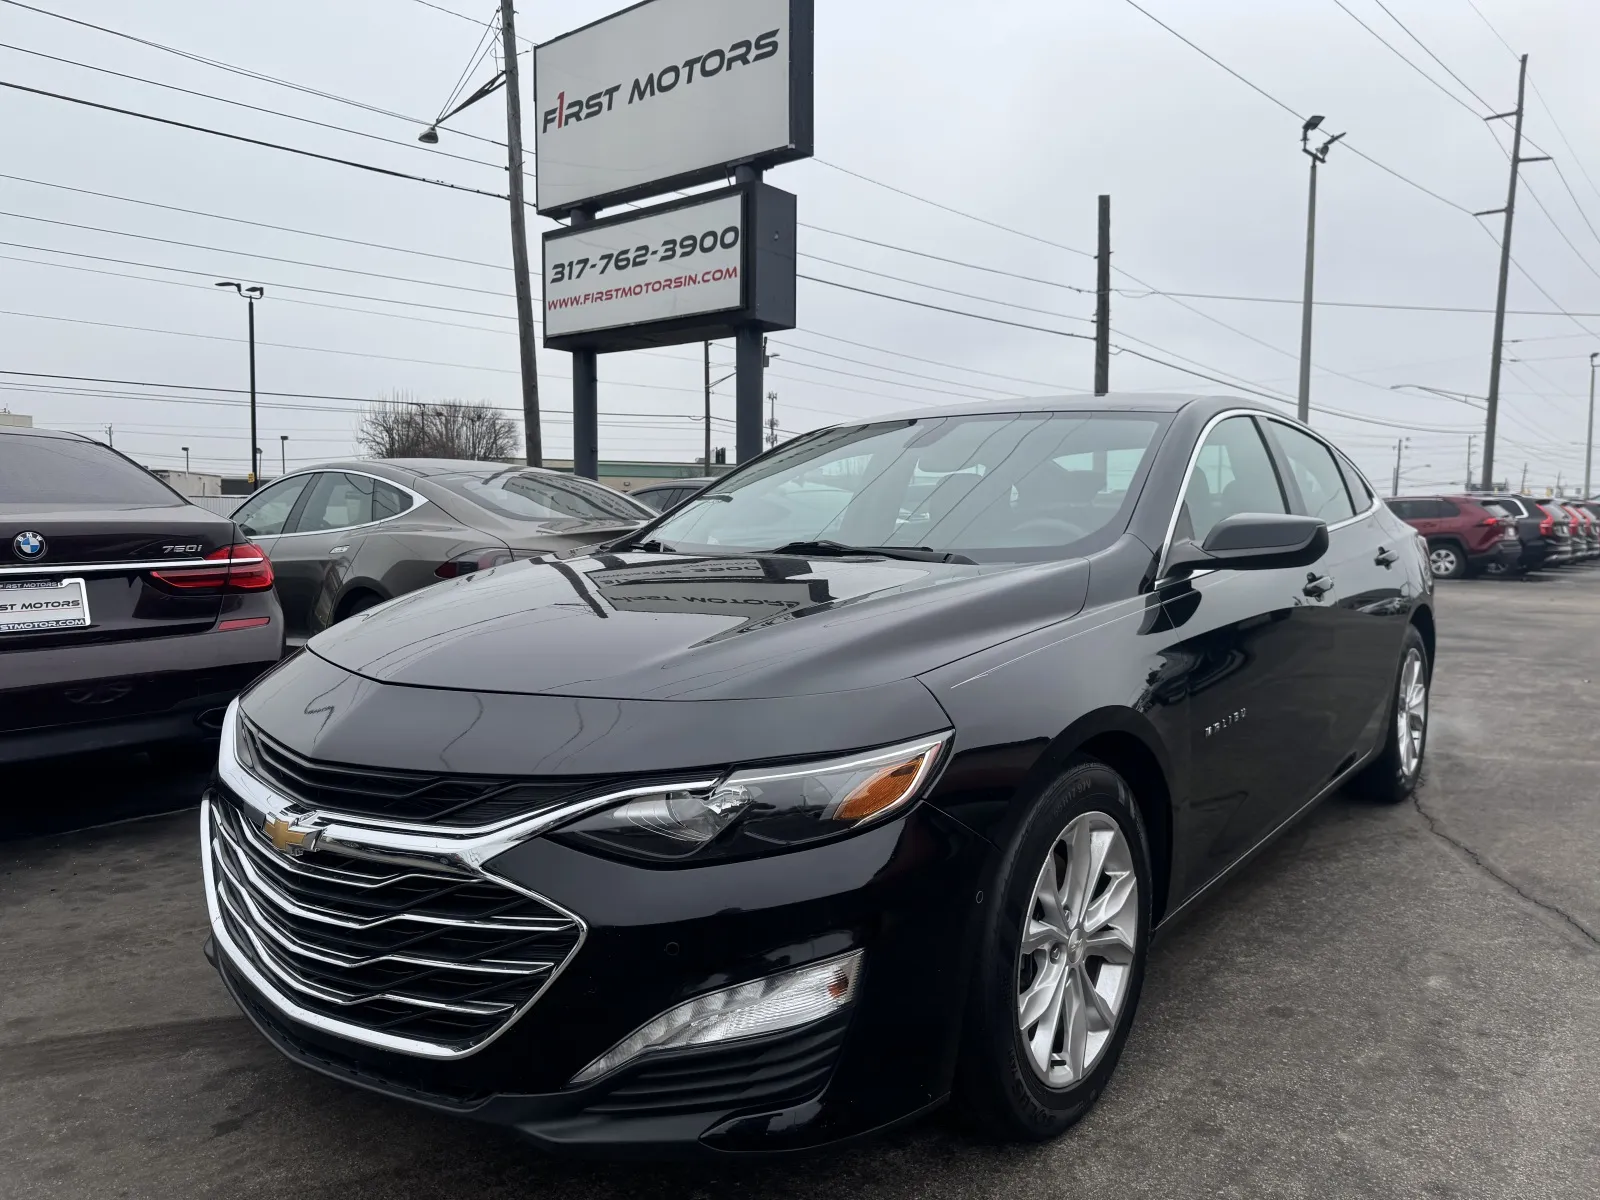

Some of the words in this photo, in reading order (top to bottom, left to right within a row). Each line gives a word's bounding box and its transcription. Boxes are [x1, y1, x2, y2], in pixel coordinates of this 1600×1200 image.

[628, 28, 780, 104] MOTORS
[550, 225, 739, 284] 317-762-3900
[548, 266, 737, 310] WWW.FIRSTMOTORSIN.COM
[17, 533, 42, 541] BMW
[162, 544, 203, 554] 750i
[21, 599, 80, 610] MOTORS
[1205, 707, 1247, 738] MALIBU
